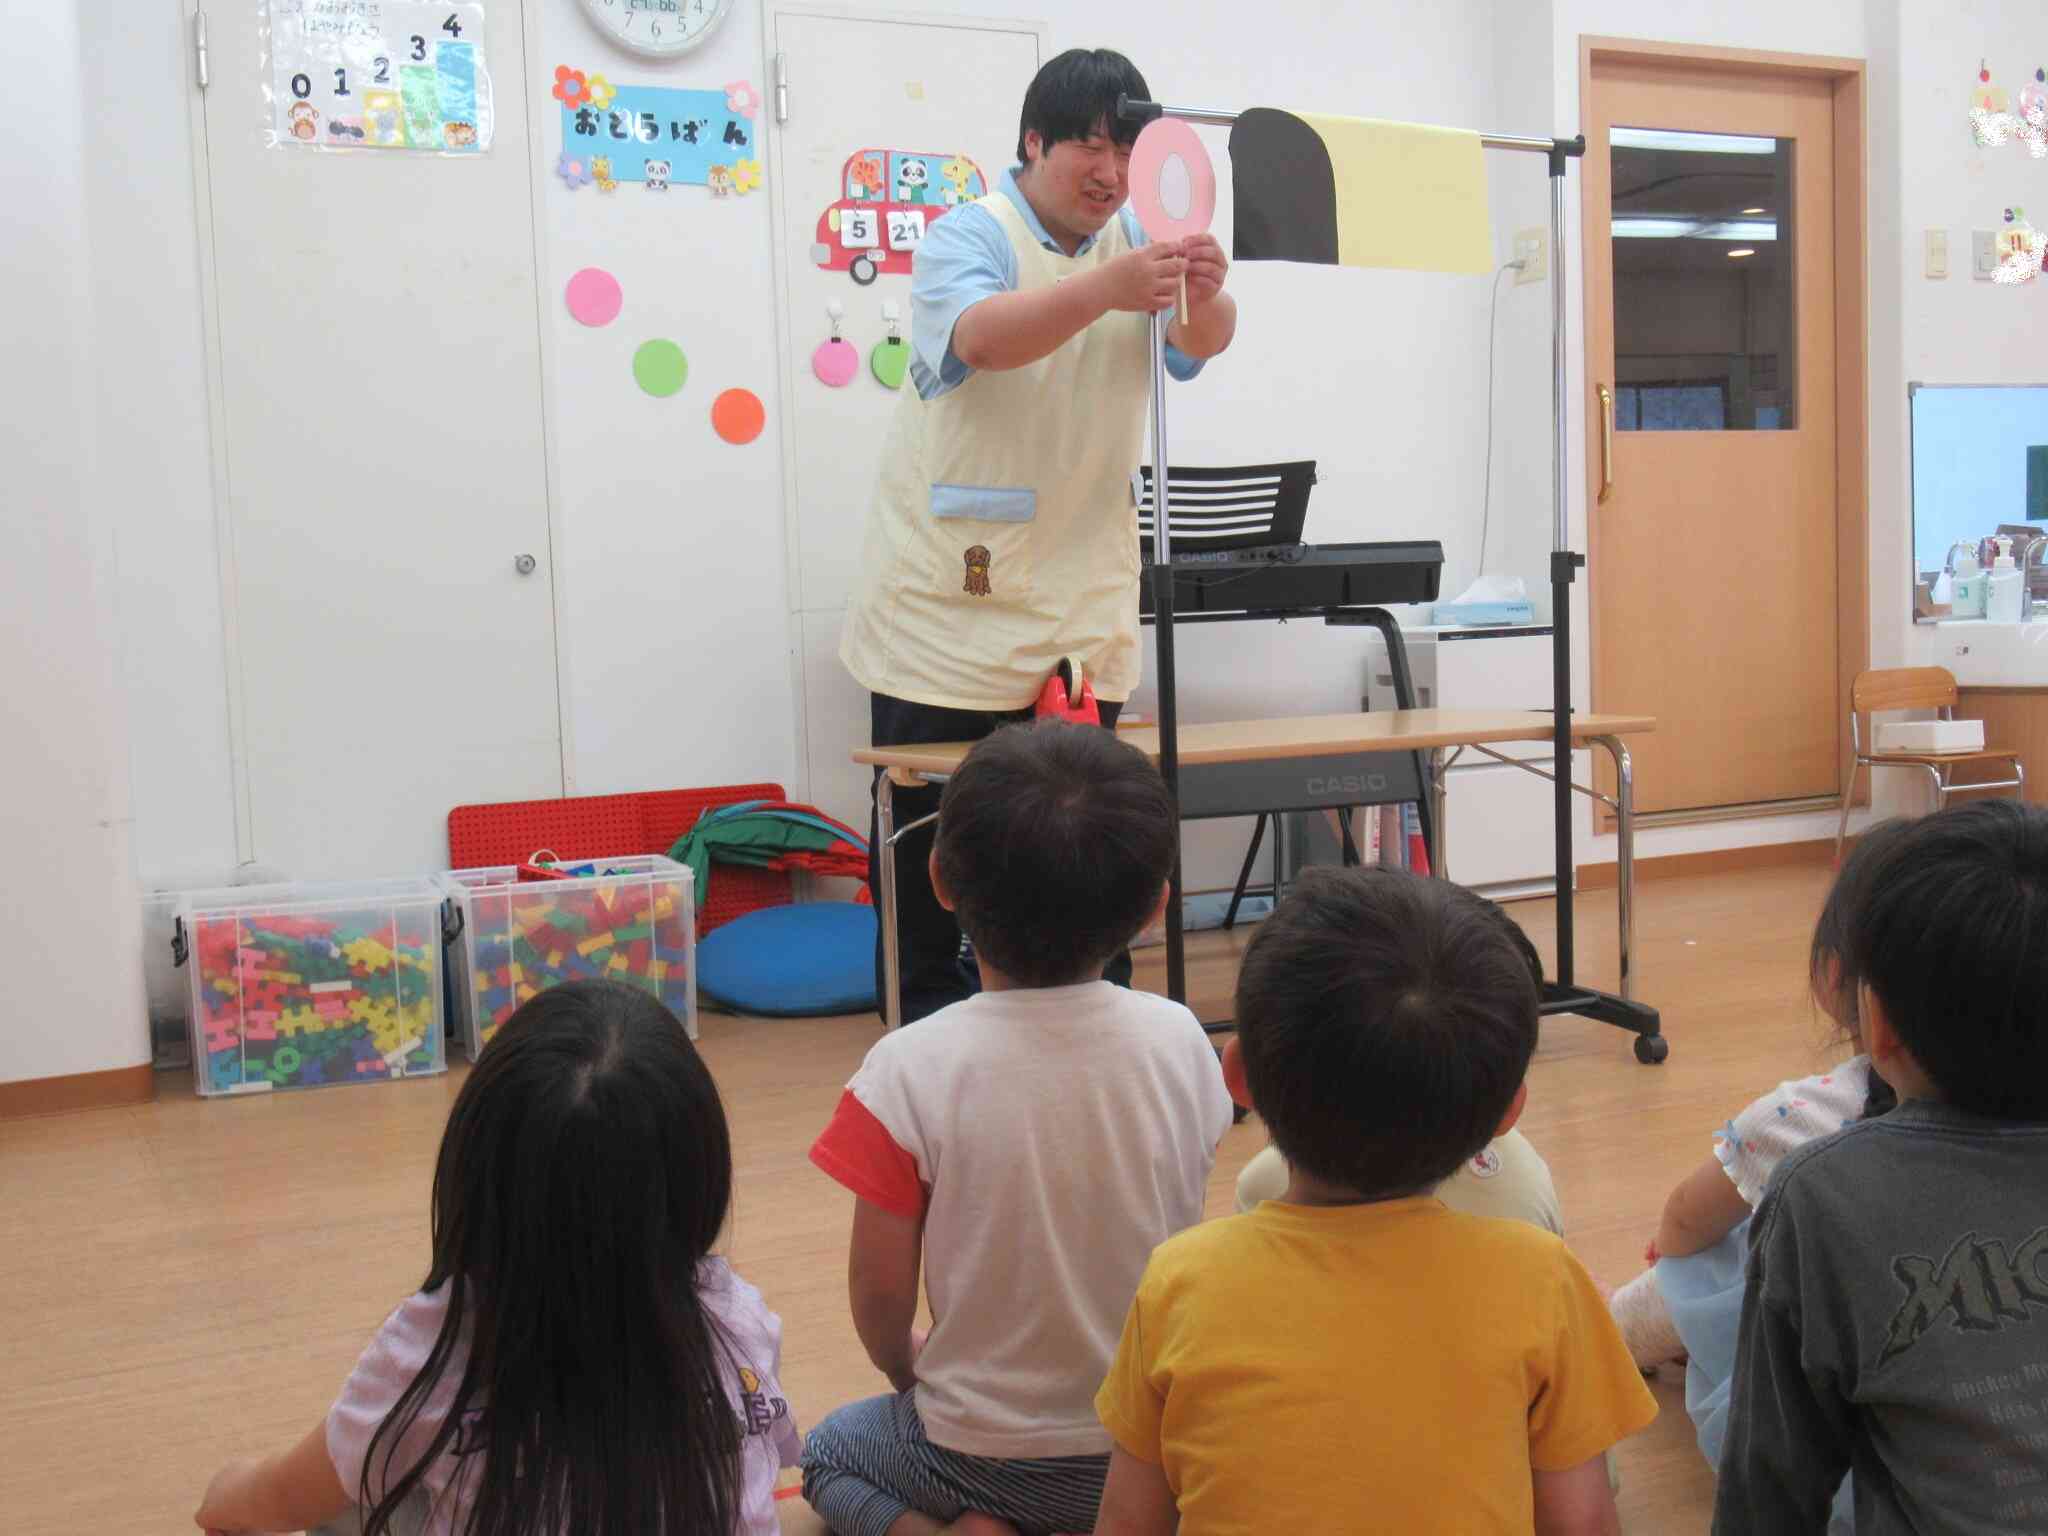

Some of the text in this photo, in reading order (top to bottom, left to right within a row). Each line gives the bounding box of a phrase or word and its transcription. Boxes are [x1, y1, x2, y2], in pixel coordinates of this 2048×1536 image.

[442, 13, 462, 38] 4
[624, 11, 634, 29] 7
[651, 15, 662, 37] 6
[677, 16, 689, 33] 5
[410, 35, 427, 61] 3
[373, 57, 390, 83] 2
[291, 73, 312, 98] 0
[333, 68, 350, 95] 1
[852, 220, 867, 239] 5
[892, 222, 920, 242] 21
[1306, 774, 1388, 796] CASIO
